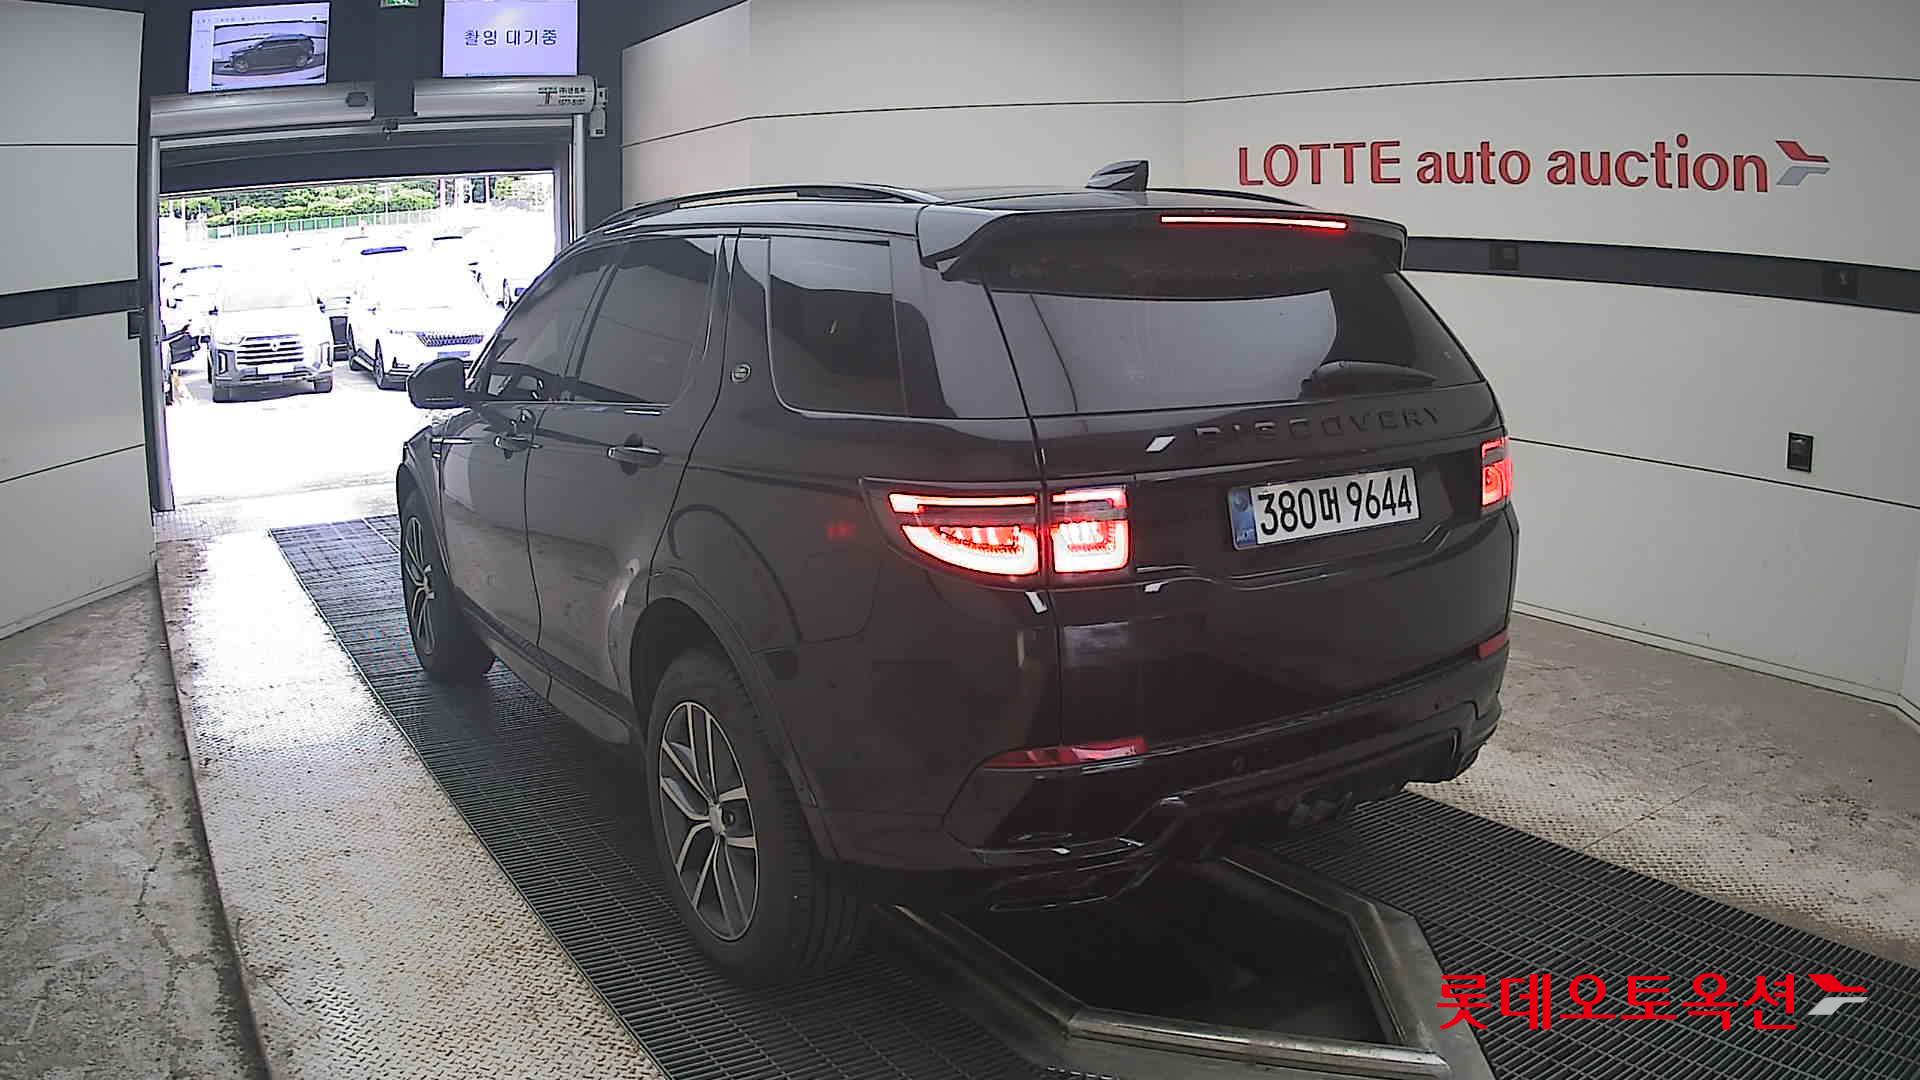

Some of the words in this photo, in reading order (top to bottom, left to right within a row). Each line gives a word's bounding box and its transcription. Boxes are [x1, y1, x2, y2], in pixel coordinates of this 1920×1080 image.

[505, 29, 559, 46] 대기중
[1239, 140, 1400, 187] LOTTE
[1416, 141, 1531, 185] auto
[1547, 133, 1768, 193] auction
[1194, 406, 1441, 444] DISCOVERY
[1257, 485, 1340, 536] 380머
[1346, 475, 1412, 523] 9644
